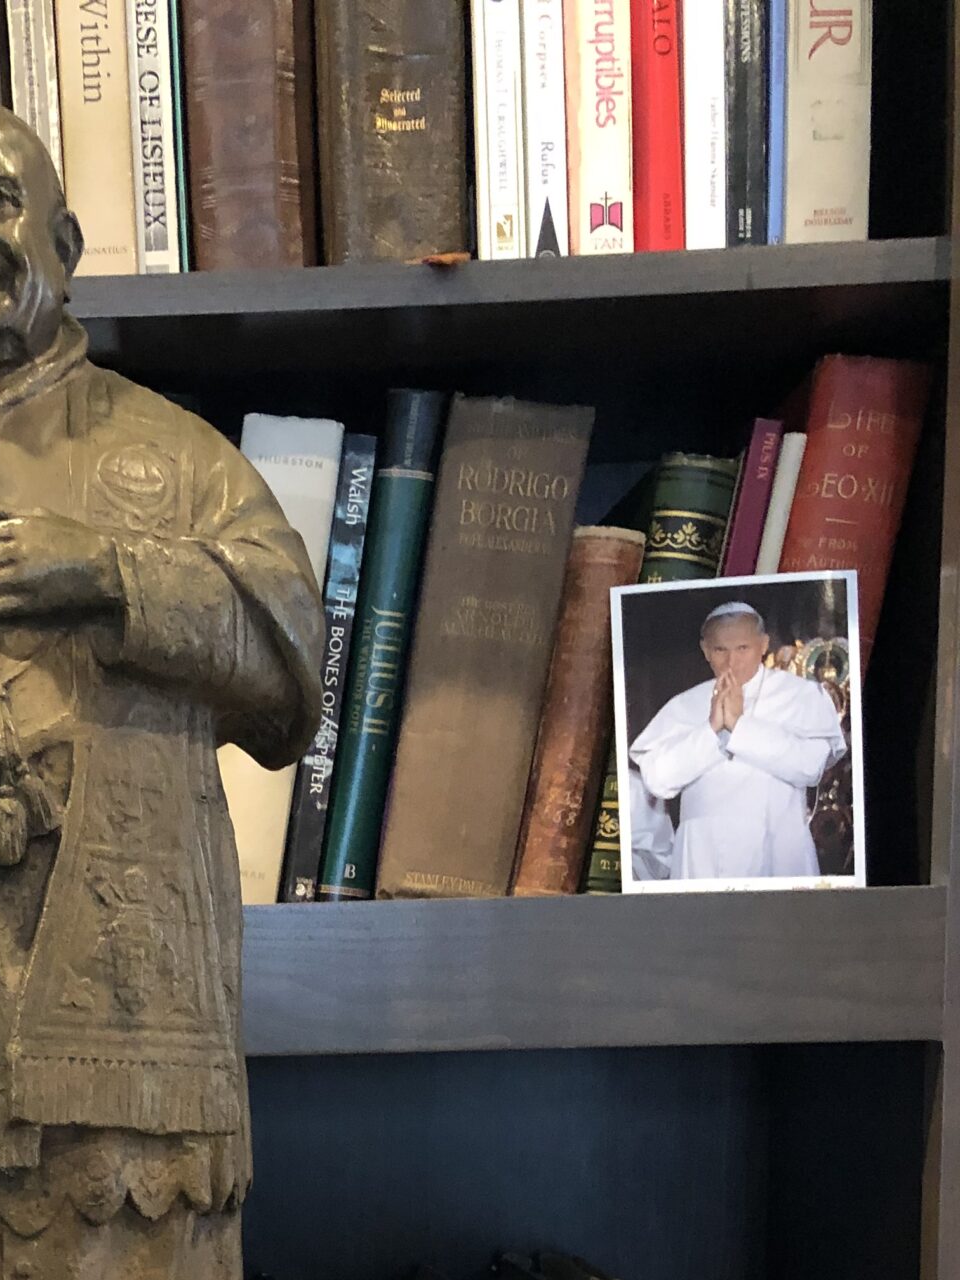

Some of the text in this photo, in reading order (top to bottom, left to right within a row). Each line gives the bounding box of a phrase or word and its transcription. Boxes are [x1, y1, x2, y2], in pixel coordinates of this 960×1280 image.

[139, 71, 161, 110] OF
[380, 88, 421, 103] Selected
[140, 117, 167, 230] LISIEUX
[540, 141, 556, 185] Rufus
[591, 238, 624, 250] TAN
[756, 432, 777, 481] PIUS IX
[842, 444, 869, 459] OF
[345, 467, 368, 526] Walsh
[457, 464, 568, 500] RODRIGO
[459, 499, 556, 536] BORGIA
[333, 587, 352, 620] THE
[325, 625, 345, 686] BONES
[362, 605, 406, 735] JULIUS II
[322, 691, 336, 716] OF
